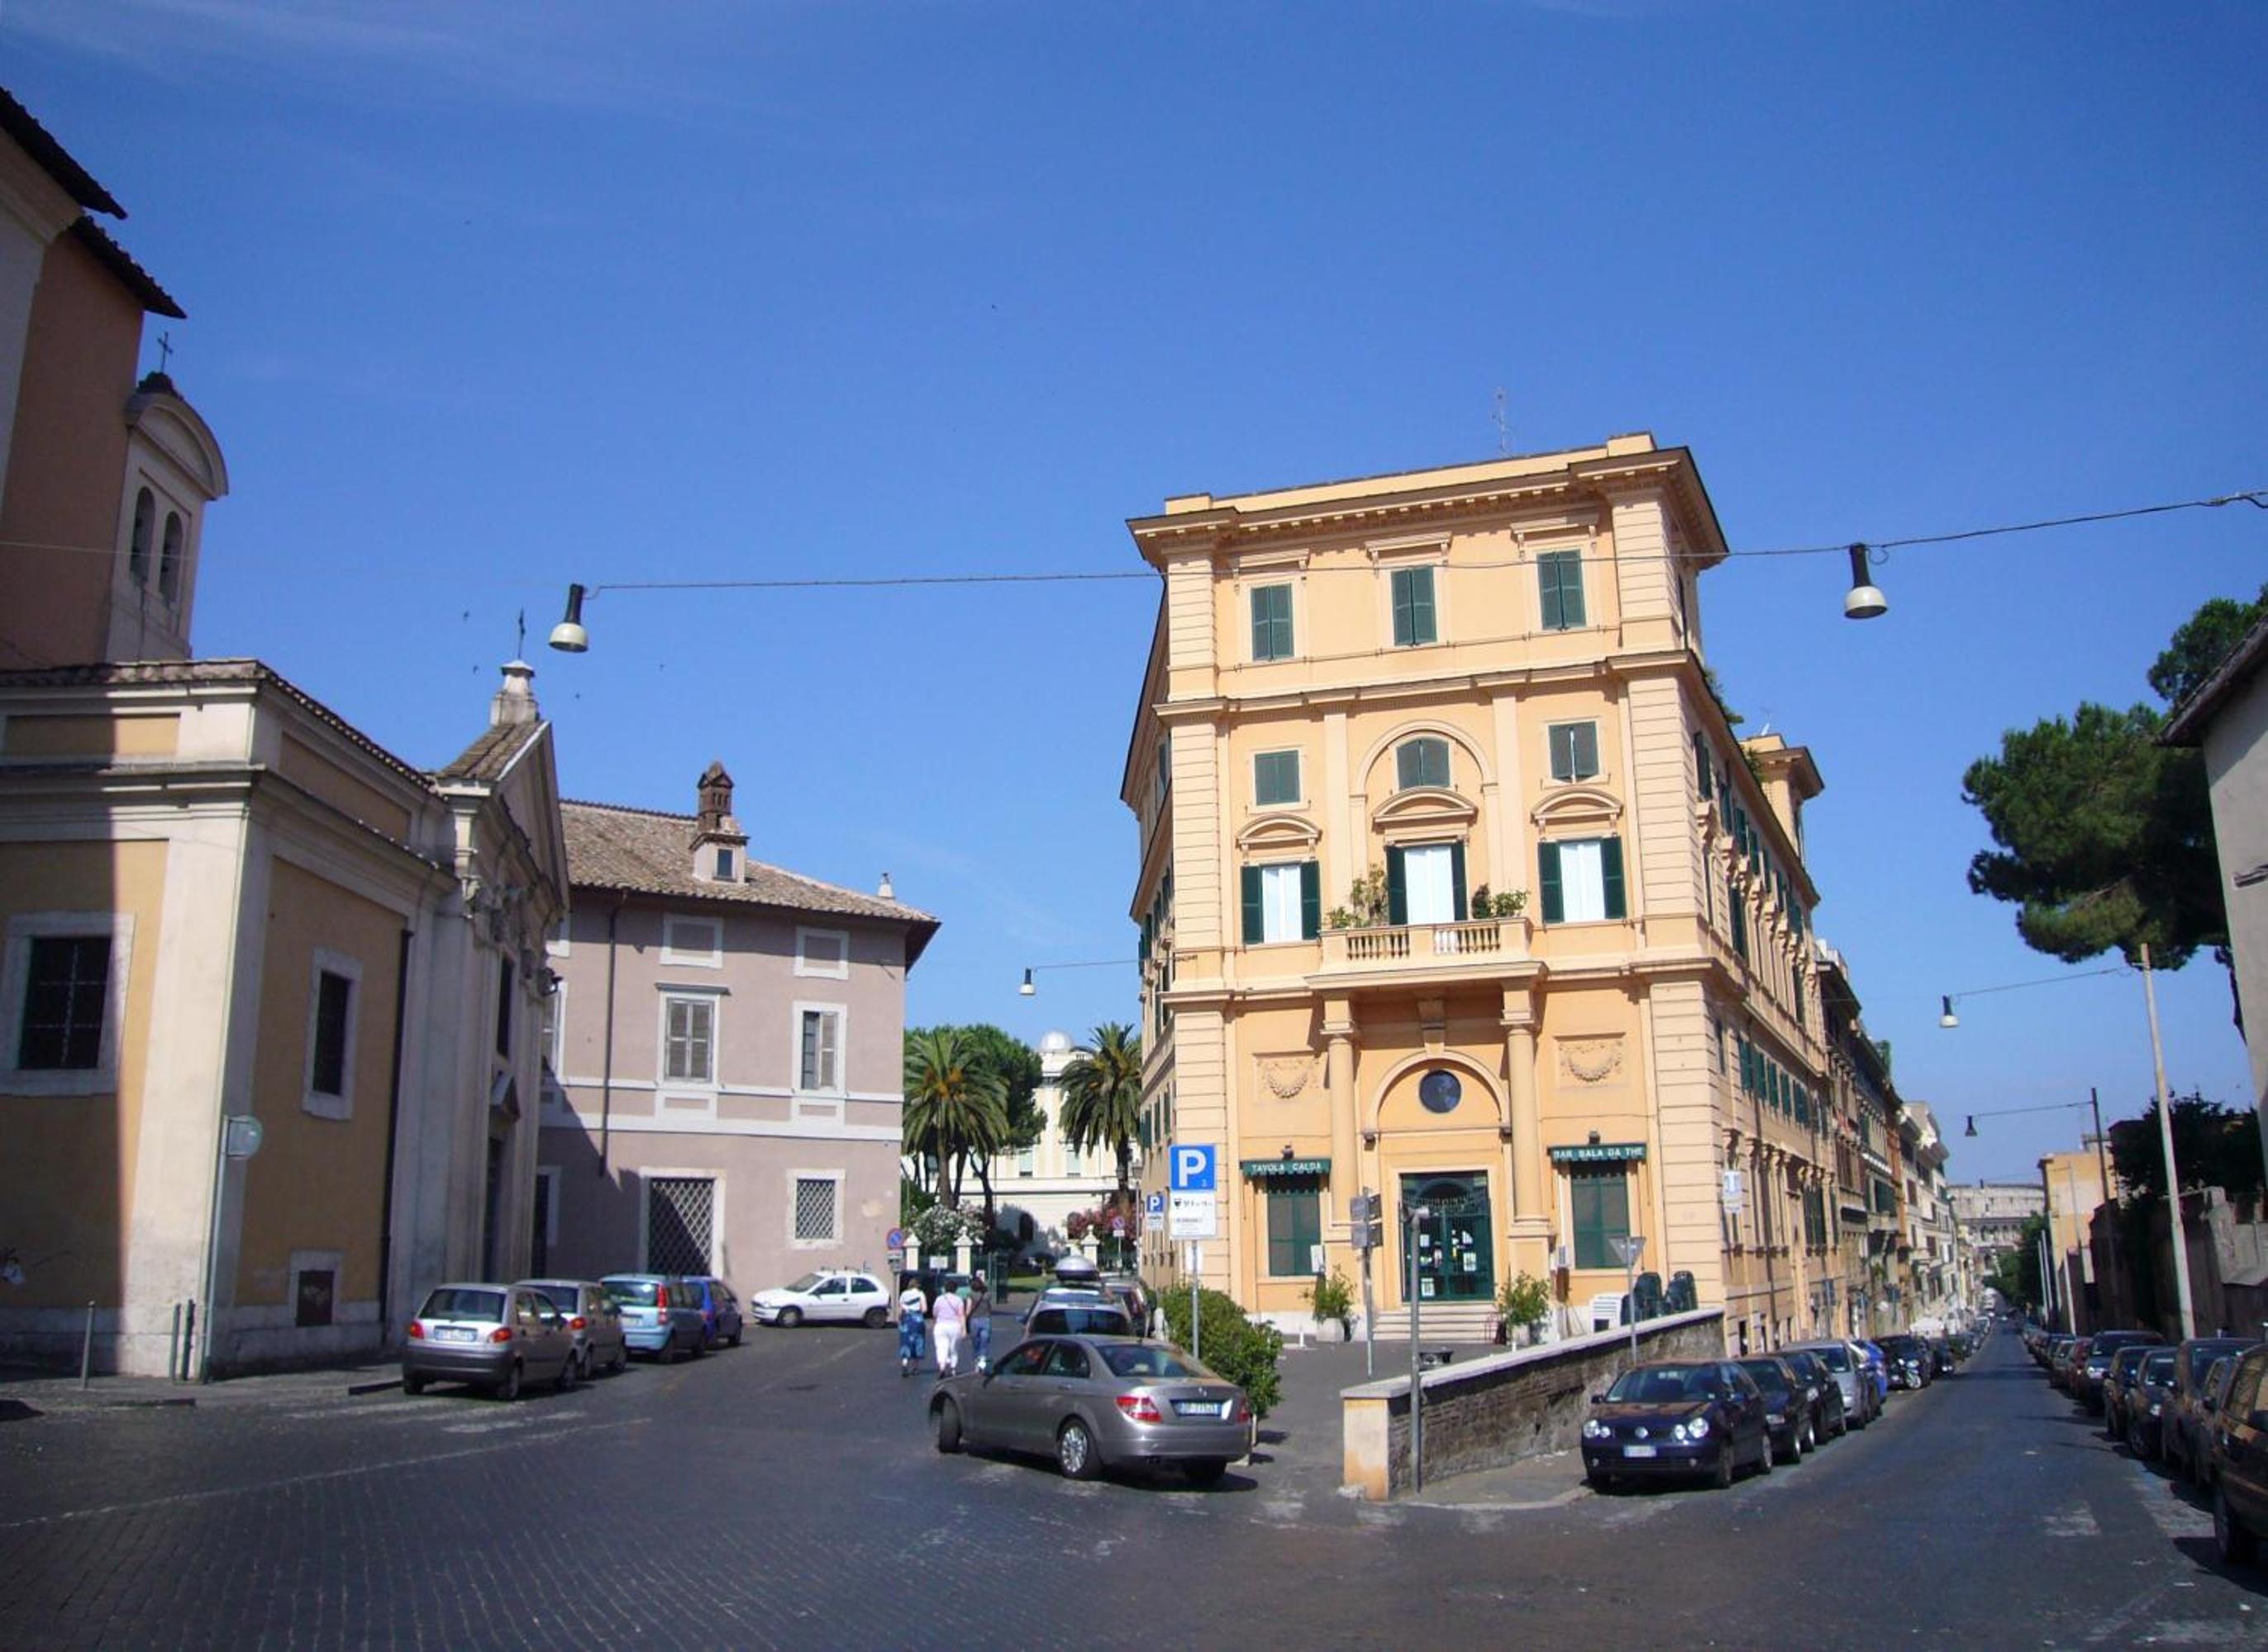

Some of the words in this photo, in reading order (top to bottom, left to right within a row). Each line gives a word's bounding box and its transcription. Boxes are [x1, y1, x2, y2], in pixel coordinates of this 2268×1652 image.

[1554, 1150, 1573, 1159] BAR
[1608, 1147, 1621, 1156] DA
[1179, 1150, 1206, 1187] P
[1252, 1163, 1284, 1173] TAVOLA
[1292, 1161, 1321, 1171] CALDA
[1150, 1196, 1160, 1212] P
